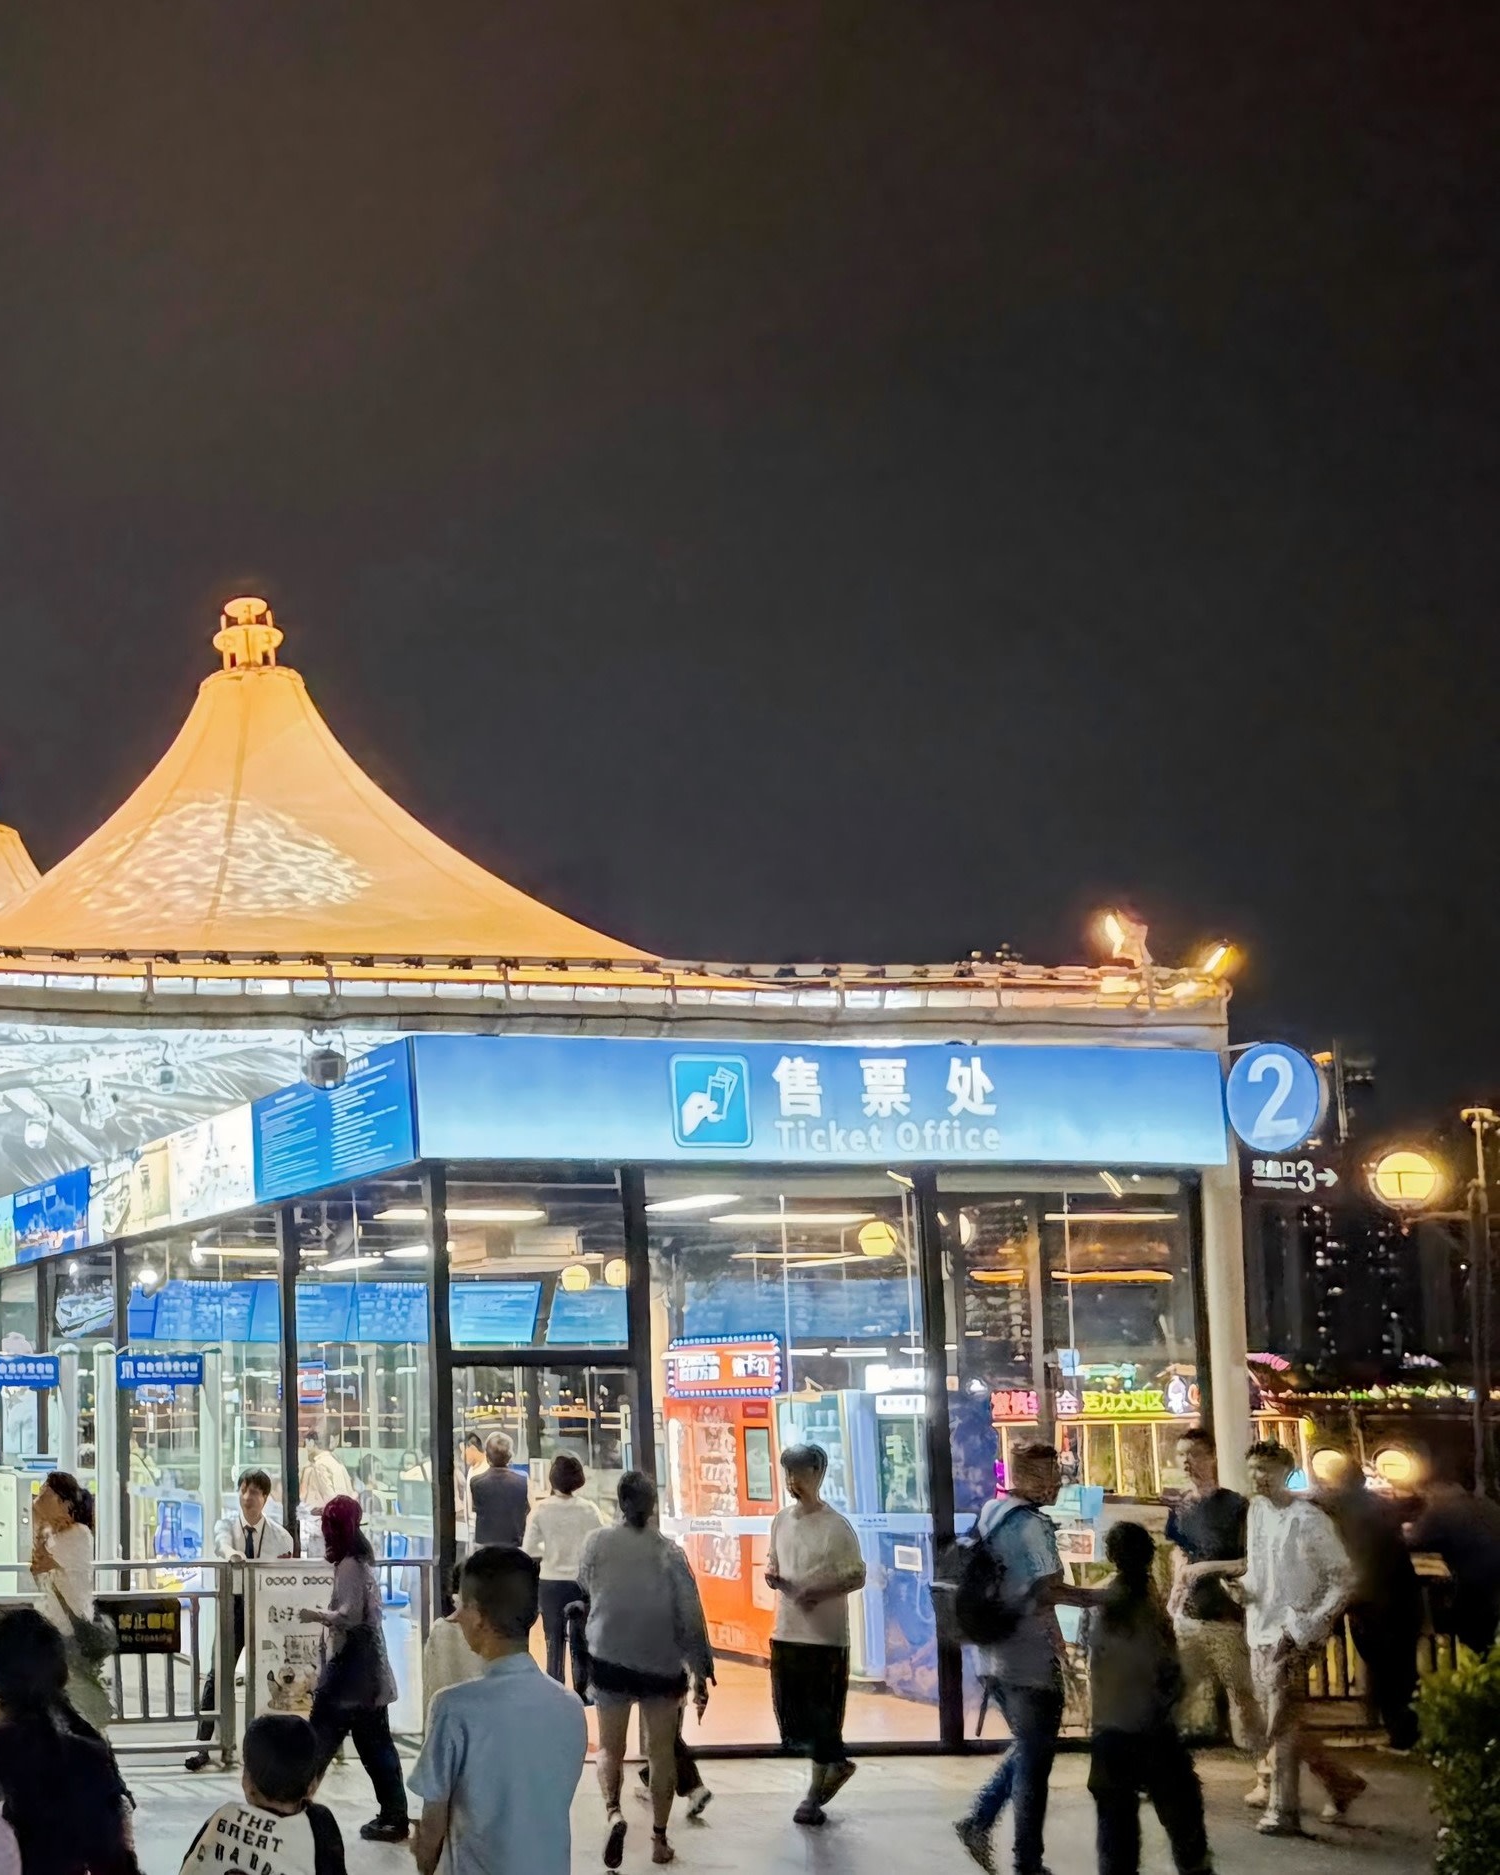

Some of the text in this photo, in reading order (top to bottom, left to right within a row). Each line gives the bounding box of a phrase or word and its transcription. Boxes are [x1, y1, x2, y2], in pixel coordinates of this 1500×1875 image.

[771, 1055, 998, 1118] 售票处
[1247, 1053, 1299, 1139] 2
[774, 1119, 1000, 1152] Ticket Office
[1296, 1160, 1316, 1193] 3
[216, 1818, 284, 1853] GREAT
[236, 1808, 277, 1833] THE
